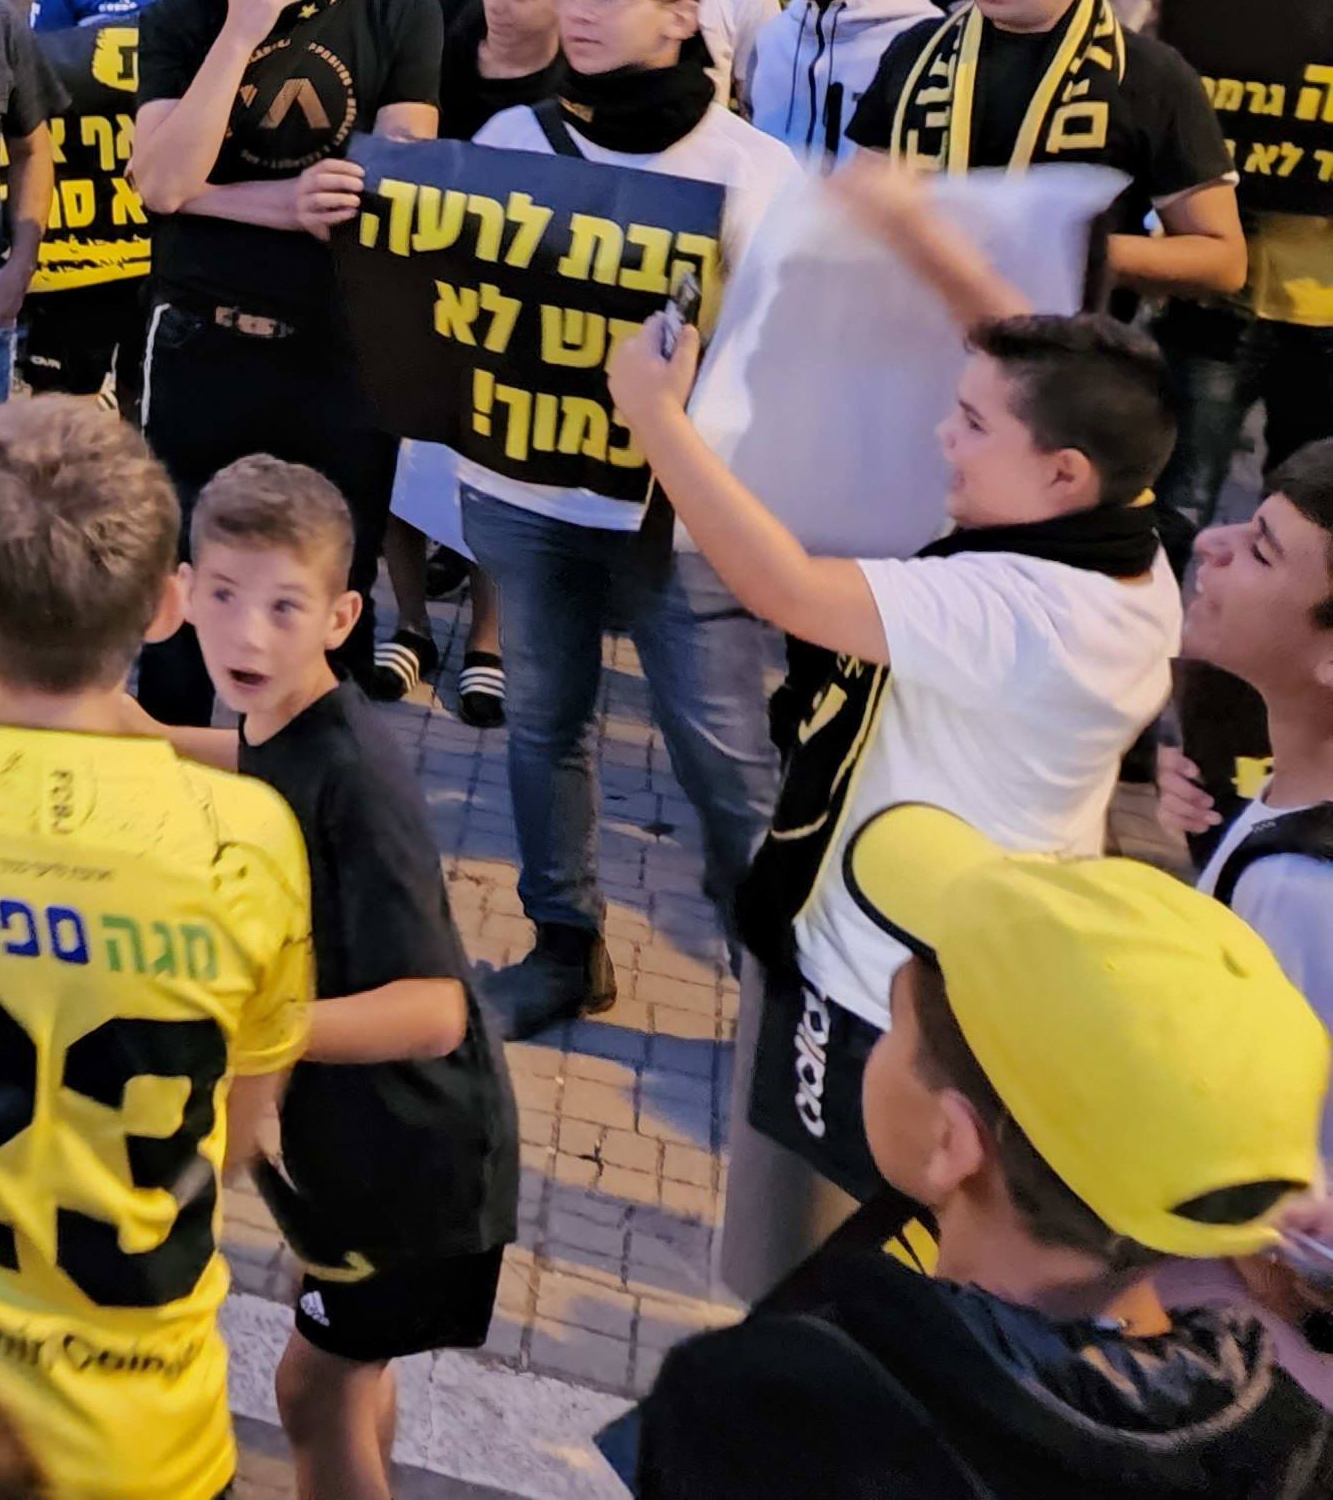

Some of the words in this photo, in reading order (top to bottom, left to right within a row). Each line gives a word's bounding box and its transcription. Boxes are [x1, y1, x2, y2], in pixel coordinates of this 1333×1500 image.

[1242, 141, 1305, 177] לא
[433, 277, 523, 354] לא
[101, 913, 220, 982] מגה
